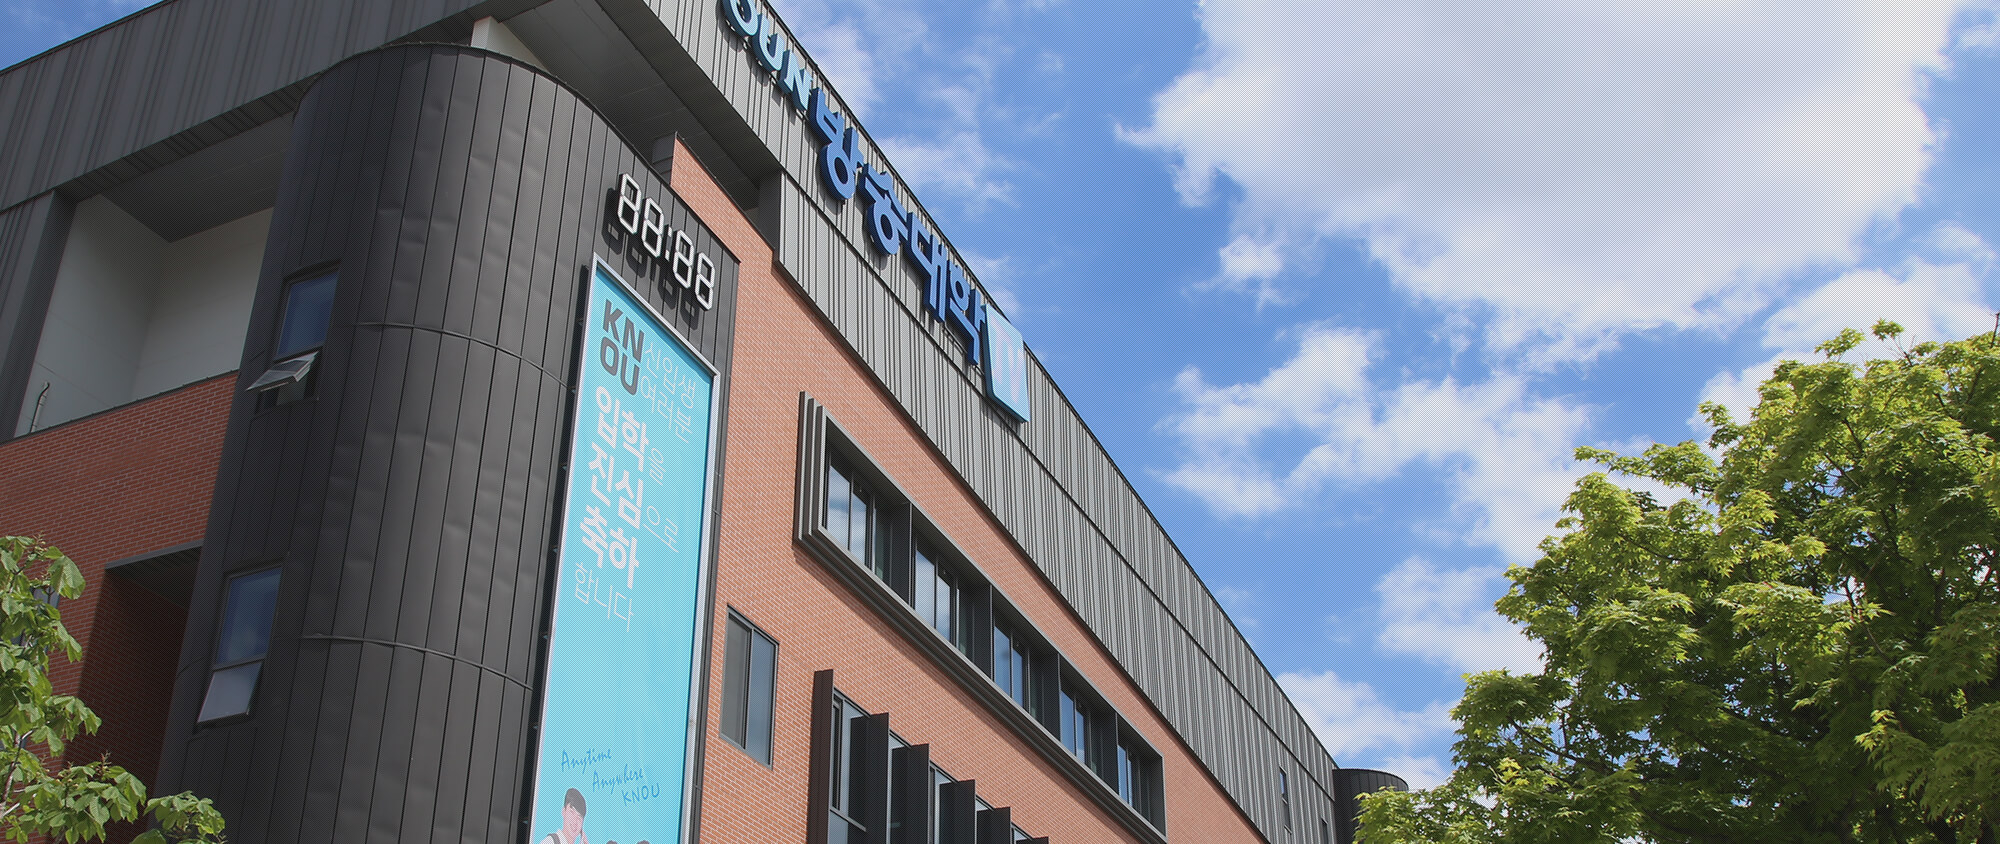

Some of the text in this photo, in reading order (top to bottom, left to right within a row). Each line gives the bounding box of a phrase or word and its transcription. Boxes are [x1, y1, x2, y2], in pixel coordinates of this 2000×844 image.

[617, 172, 716, 311] 88:88
[810, 87, 985, 365] 방송대학
[602, 298, 645, 363] KN
[600, 336, 641, 395] OU
[644, 342, 697, 410] 신입생
[595, 385, 667, 486] 입학을
[640, 376, 694, 444] 여러분
[588, 441, 680, 553] 진심으로
[579, 504, 640, 590] 축하
[574, 561, 635, 633] 합니다
[561, 748, 612, 775] Anytime
[592, 763, 644, 795] Anywhere
[621, 782, 661, 807] KNOU
